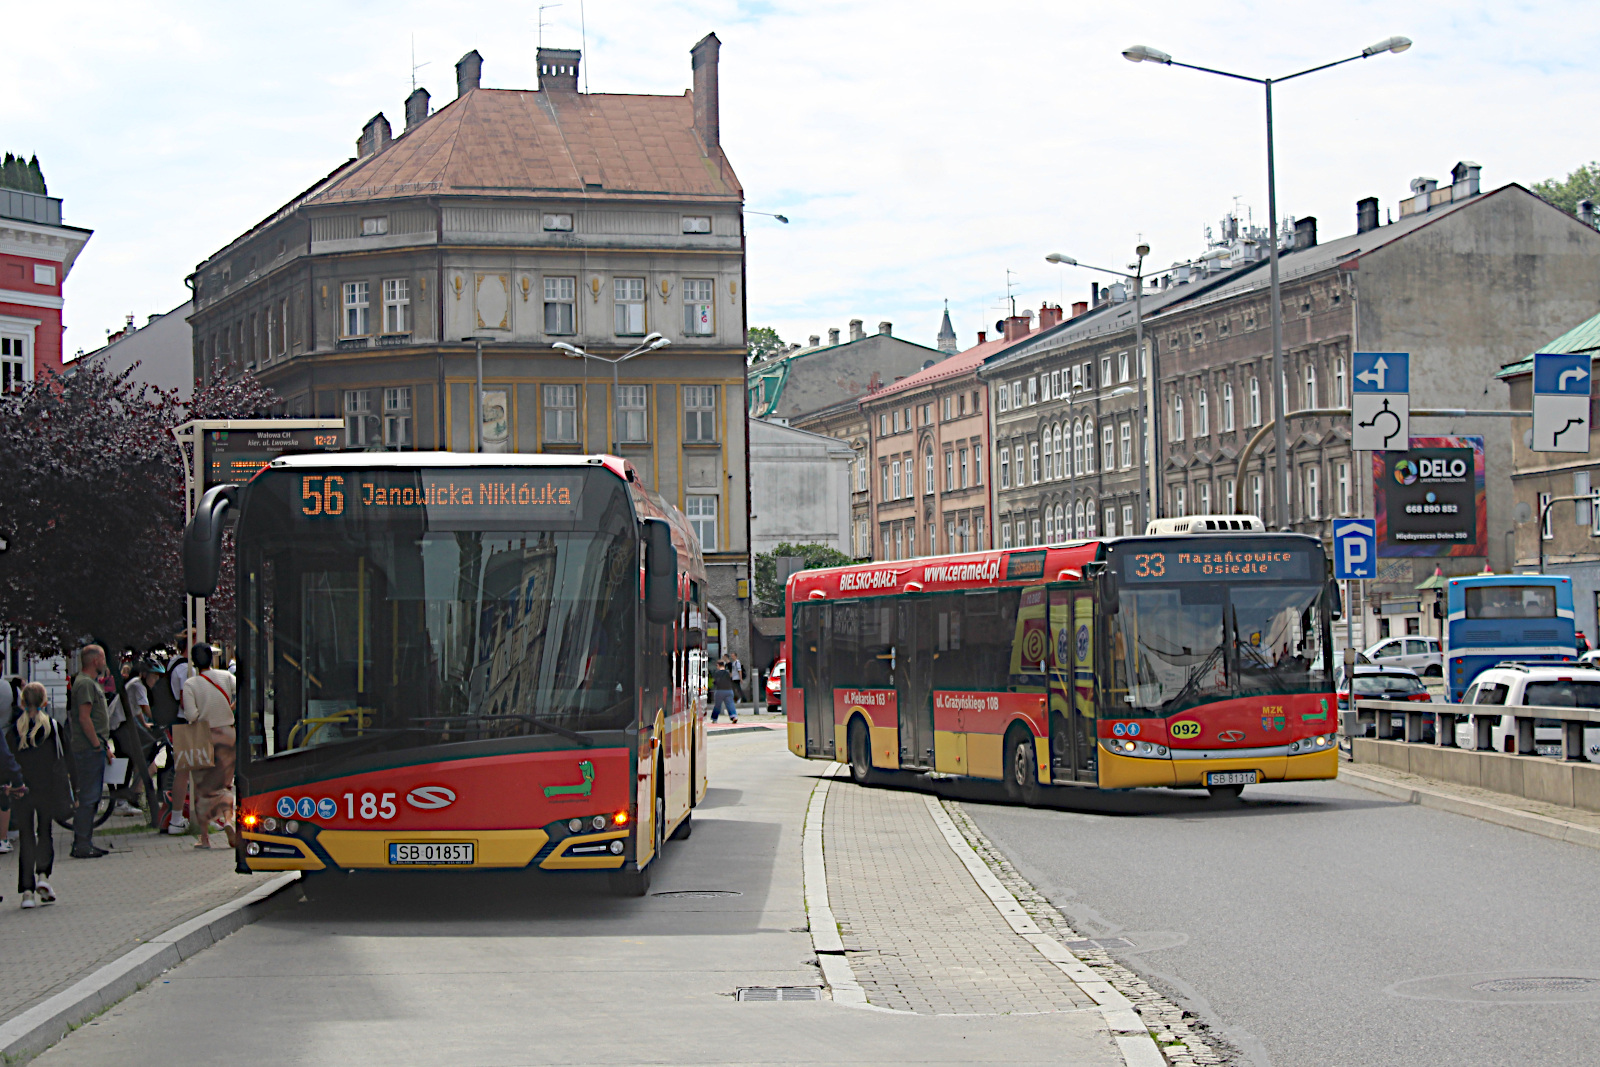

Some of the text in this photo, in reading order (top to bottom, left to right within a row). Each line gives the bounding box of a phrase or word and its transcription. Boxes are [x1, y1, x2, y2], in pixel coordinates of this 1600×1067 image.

[314, 435, 337, 445] 12:27
[1420, 459, 1466, 477] DELO
[302, 475, 571, 515] 56 Janowicka Niklówka
[1406, 505, 1457, 513] 668 890 852
[1343, 537, 1367, 573] P
[924, 558, 1000, 583] www.ceramed.pl
[1135, 551, 1291, 577] 33 Mazańcowice
[1202, 563, 1268, 574] Osiedle
[839, 570, 897, 591] BIELSKO-BIAŁA
[851, 691, 875, 705] Piekarska
[876, 693, 886, 705] 163
[936, 694, 999, 712] ul. Grażyńskiego 10B
[1262, 706, 1283, 714] MZK
[1172, 724, 1199, 735] 092
[1213, 774, 1255, 783] SB 81316
[343, 793, 396, 819] 185
[399, 846, 471, 859] SB 0185T
